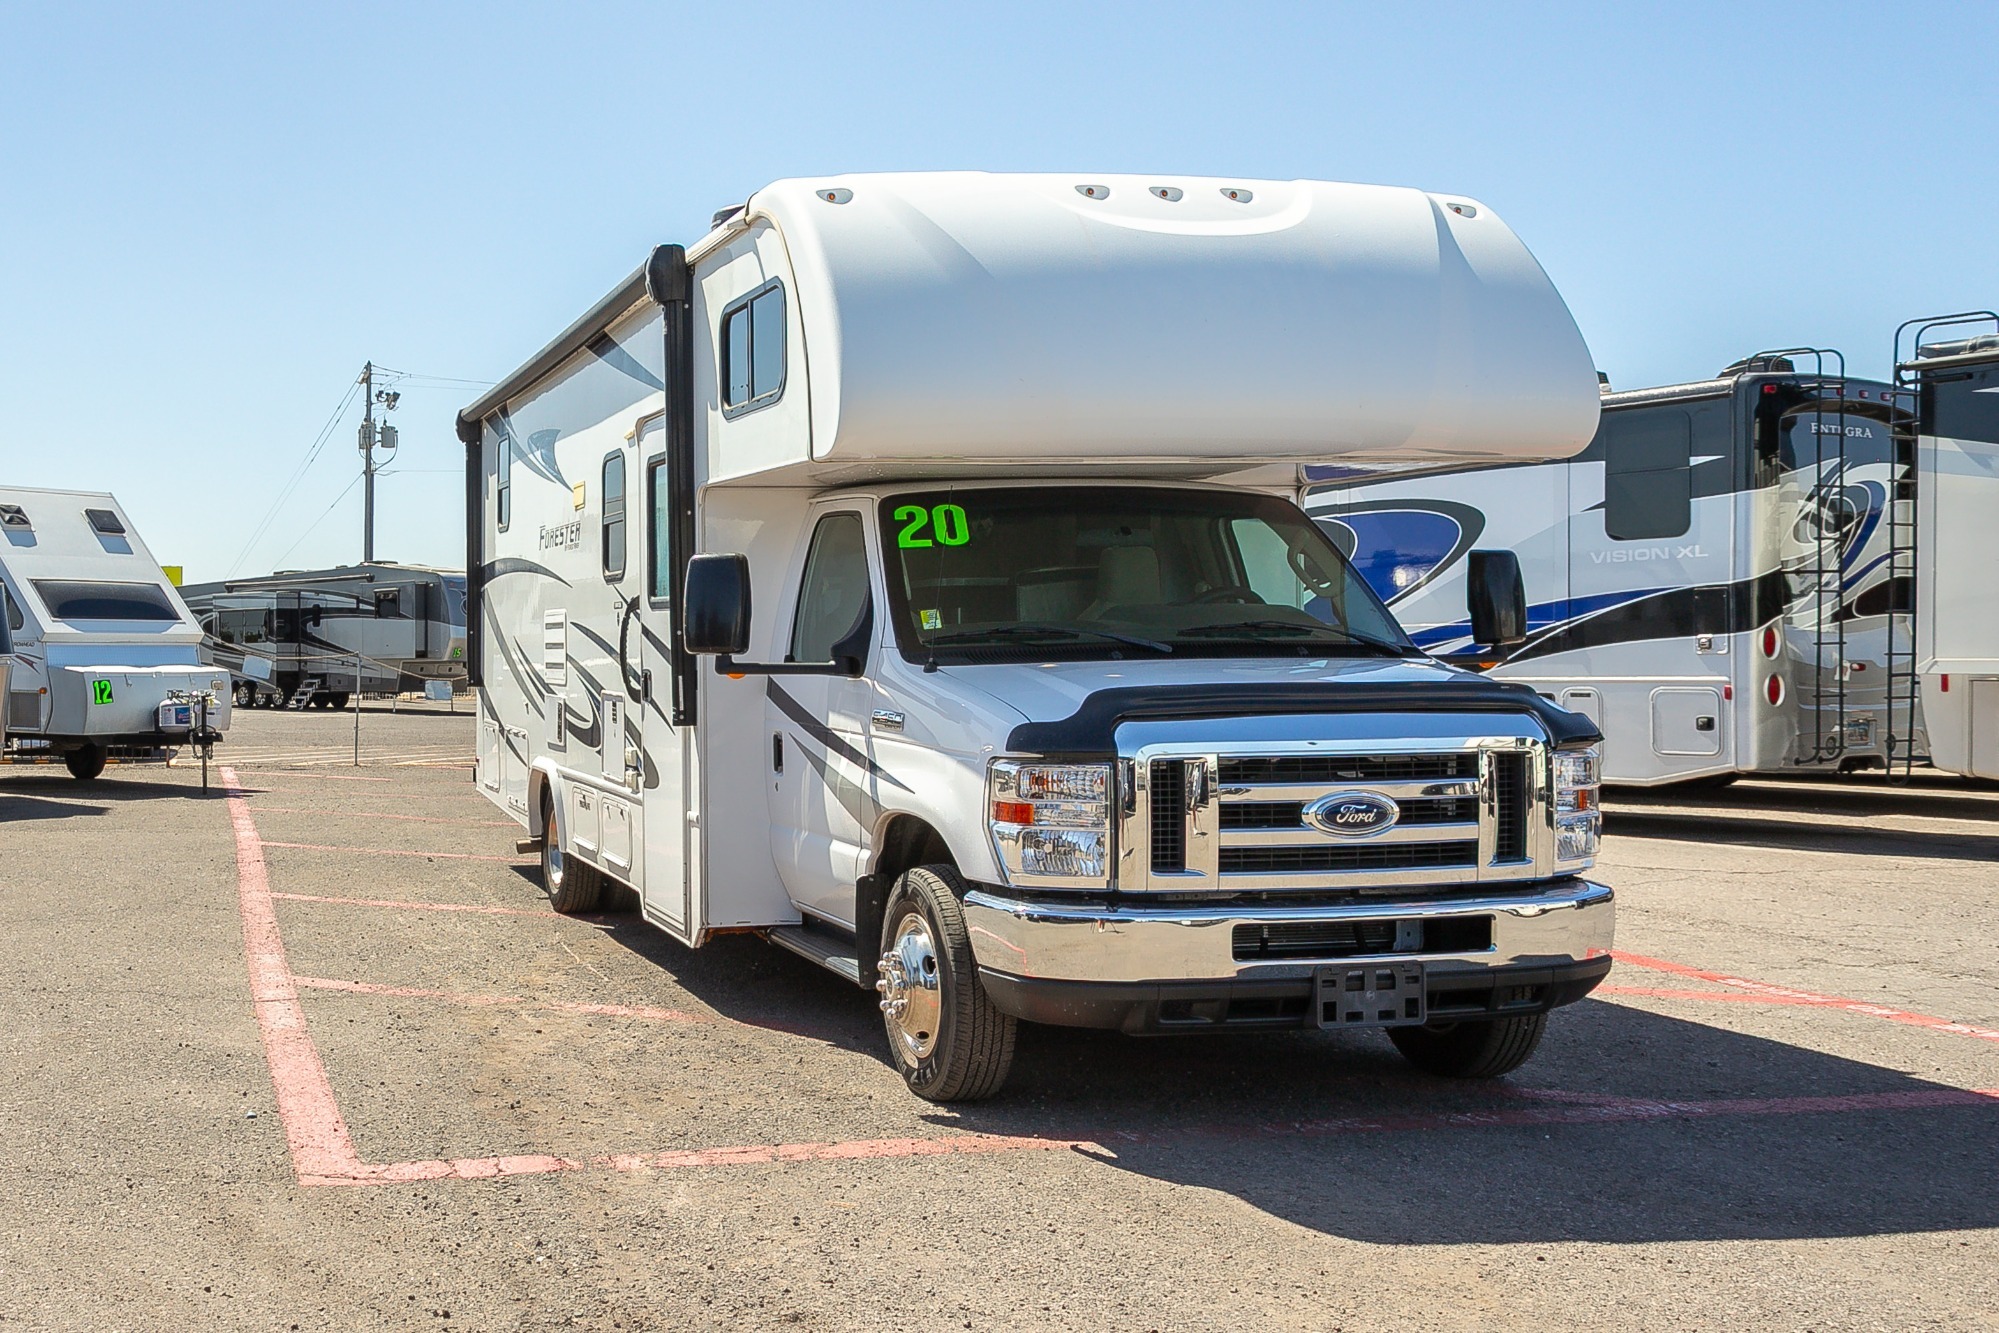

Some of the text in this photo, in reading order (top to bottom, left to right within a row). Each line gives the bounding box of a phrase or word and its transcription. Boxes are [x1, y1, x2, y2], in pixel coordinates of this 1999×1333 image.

[1810, 422, 1873, 439] ENTGRA
[538, 520, 582, 551] FORESTER
[893, 504, 970, 549] 20
[1590, 544, 1709, 564] VISION XL
[94, 681, 113, 704] 12
[1336, 804, 1378, 824] Ford
